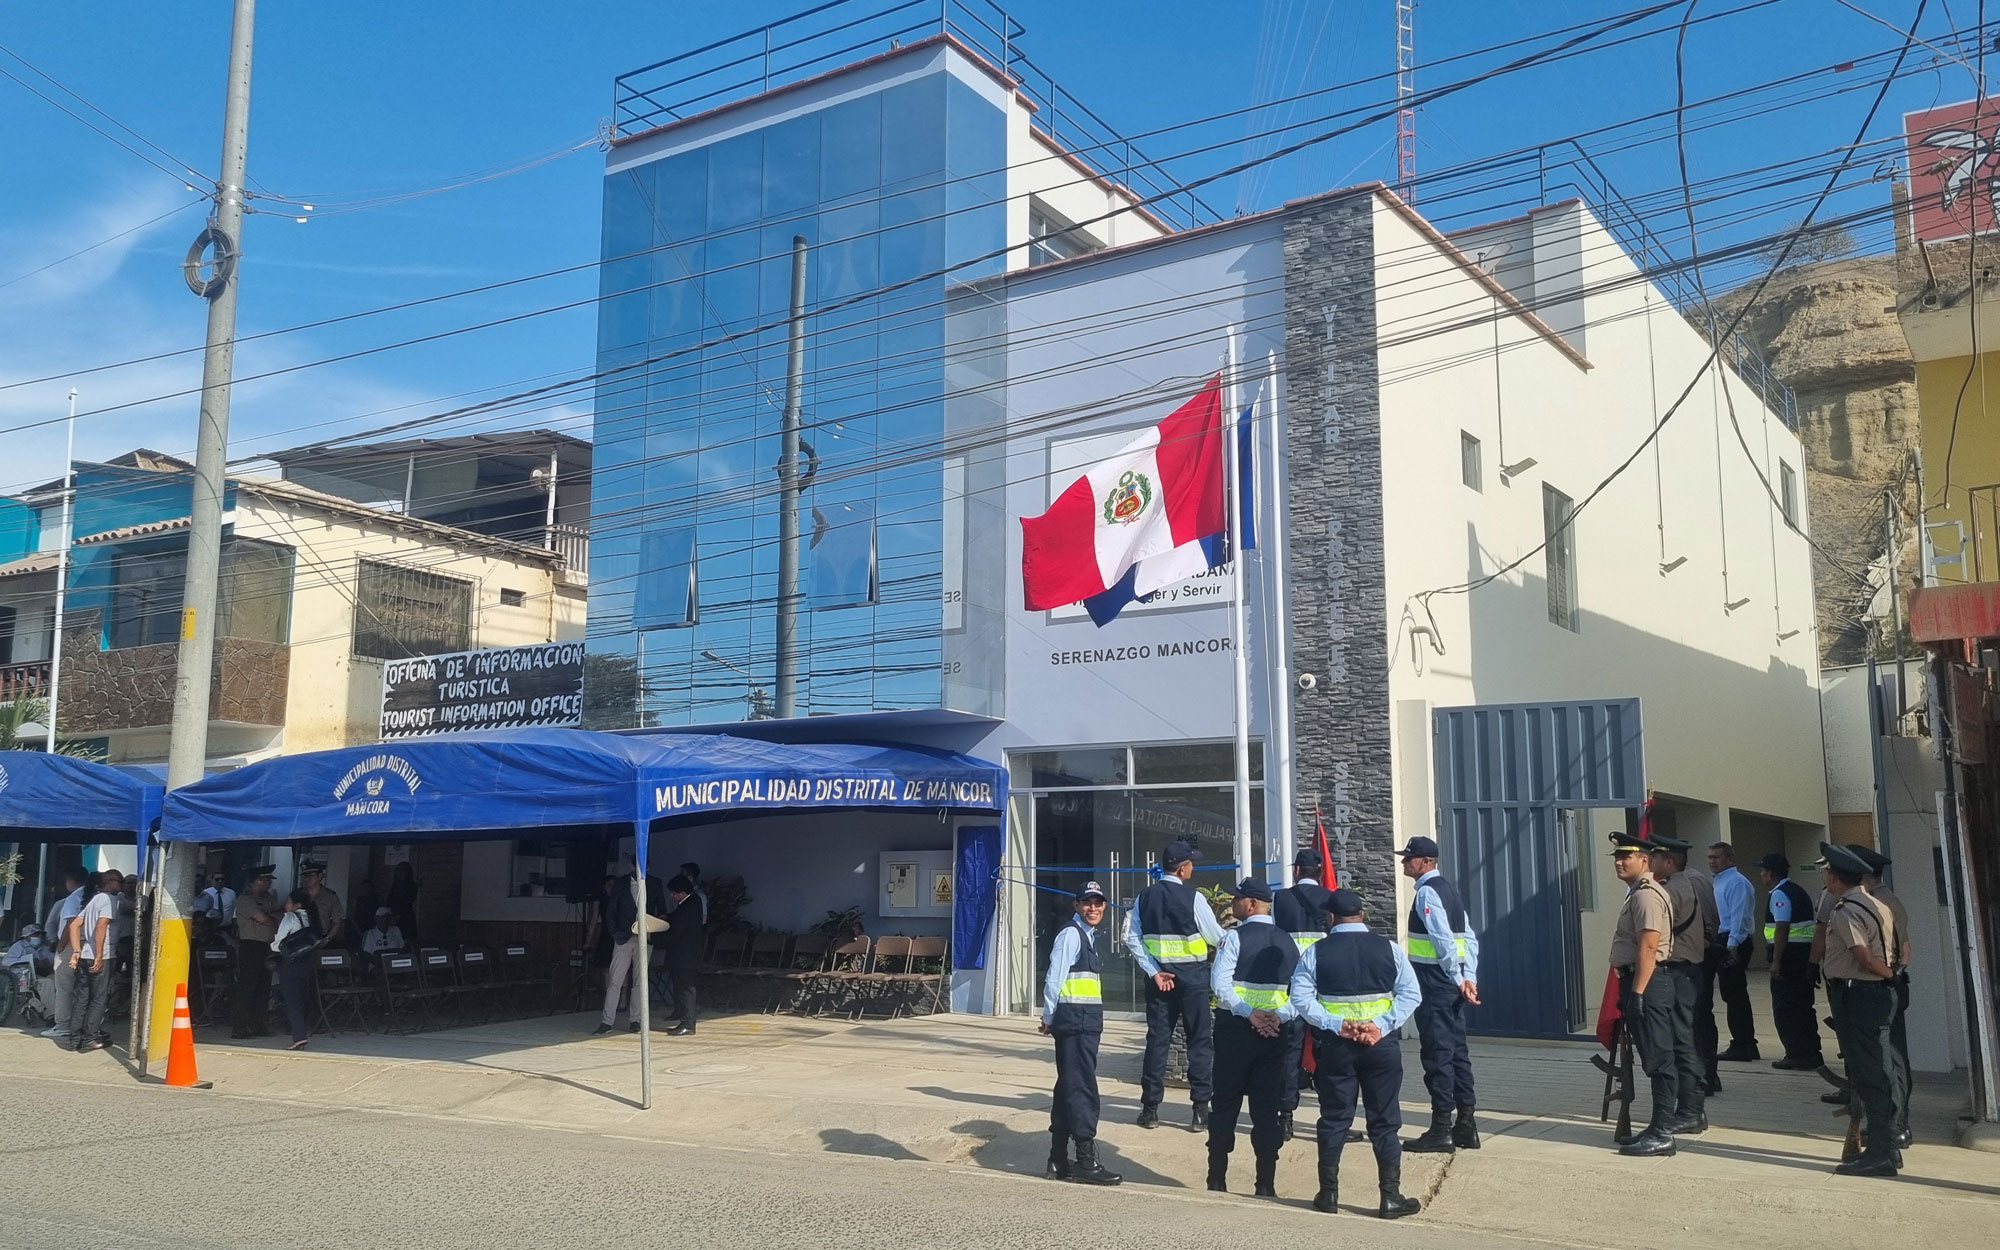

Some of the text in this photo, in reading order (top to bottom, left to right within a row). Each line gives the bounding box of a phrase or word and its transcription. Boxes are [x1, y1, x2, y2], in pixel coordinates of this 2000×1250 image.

[1321, 303, 1341, 444] VIIAR
[1171, 588, 1179, 601] y
[1183, 583, 1222, 596] Servir
[388, 646, 583, 685] OFICINA DE INFORMACION
[1051, 637, 1245, 665] SERENAZGO MANCOR
[438, 677, 510, 700] TURISTICA
[383, 694, 581, 730] TOURIST INFORMATION OFFICE
[333, 754, 422, 801] MUNICIPALIDAD DISTRITAL
[656, 779, 811, 812] MUNICIPALIDAD
[815, 778, 897, 801] DISTRITAL
[903, 780, 924, 801] DE
[1334, 762, 1353, 889] SERVIR
